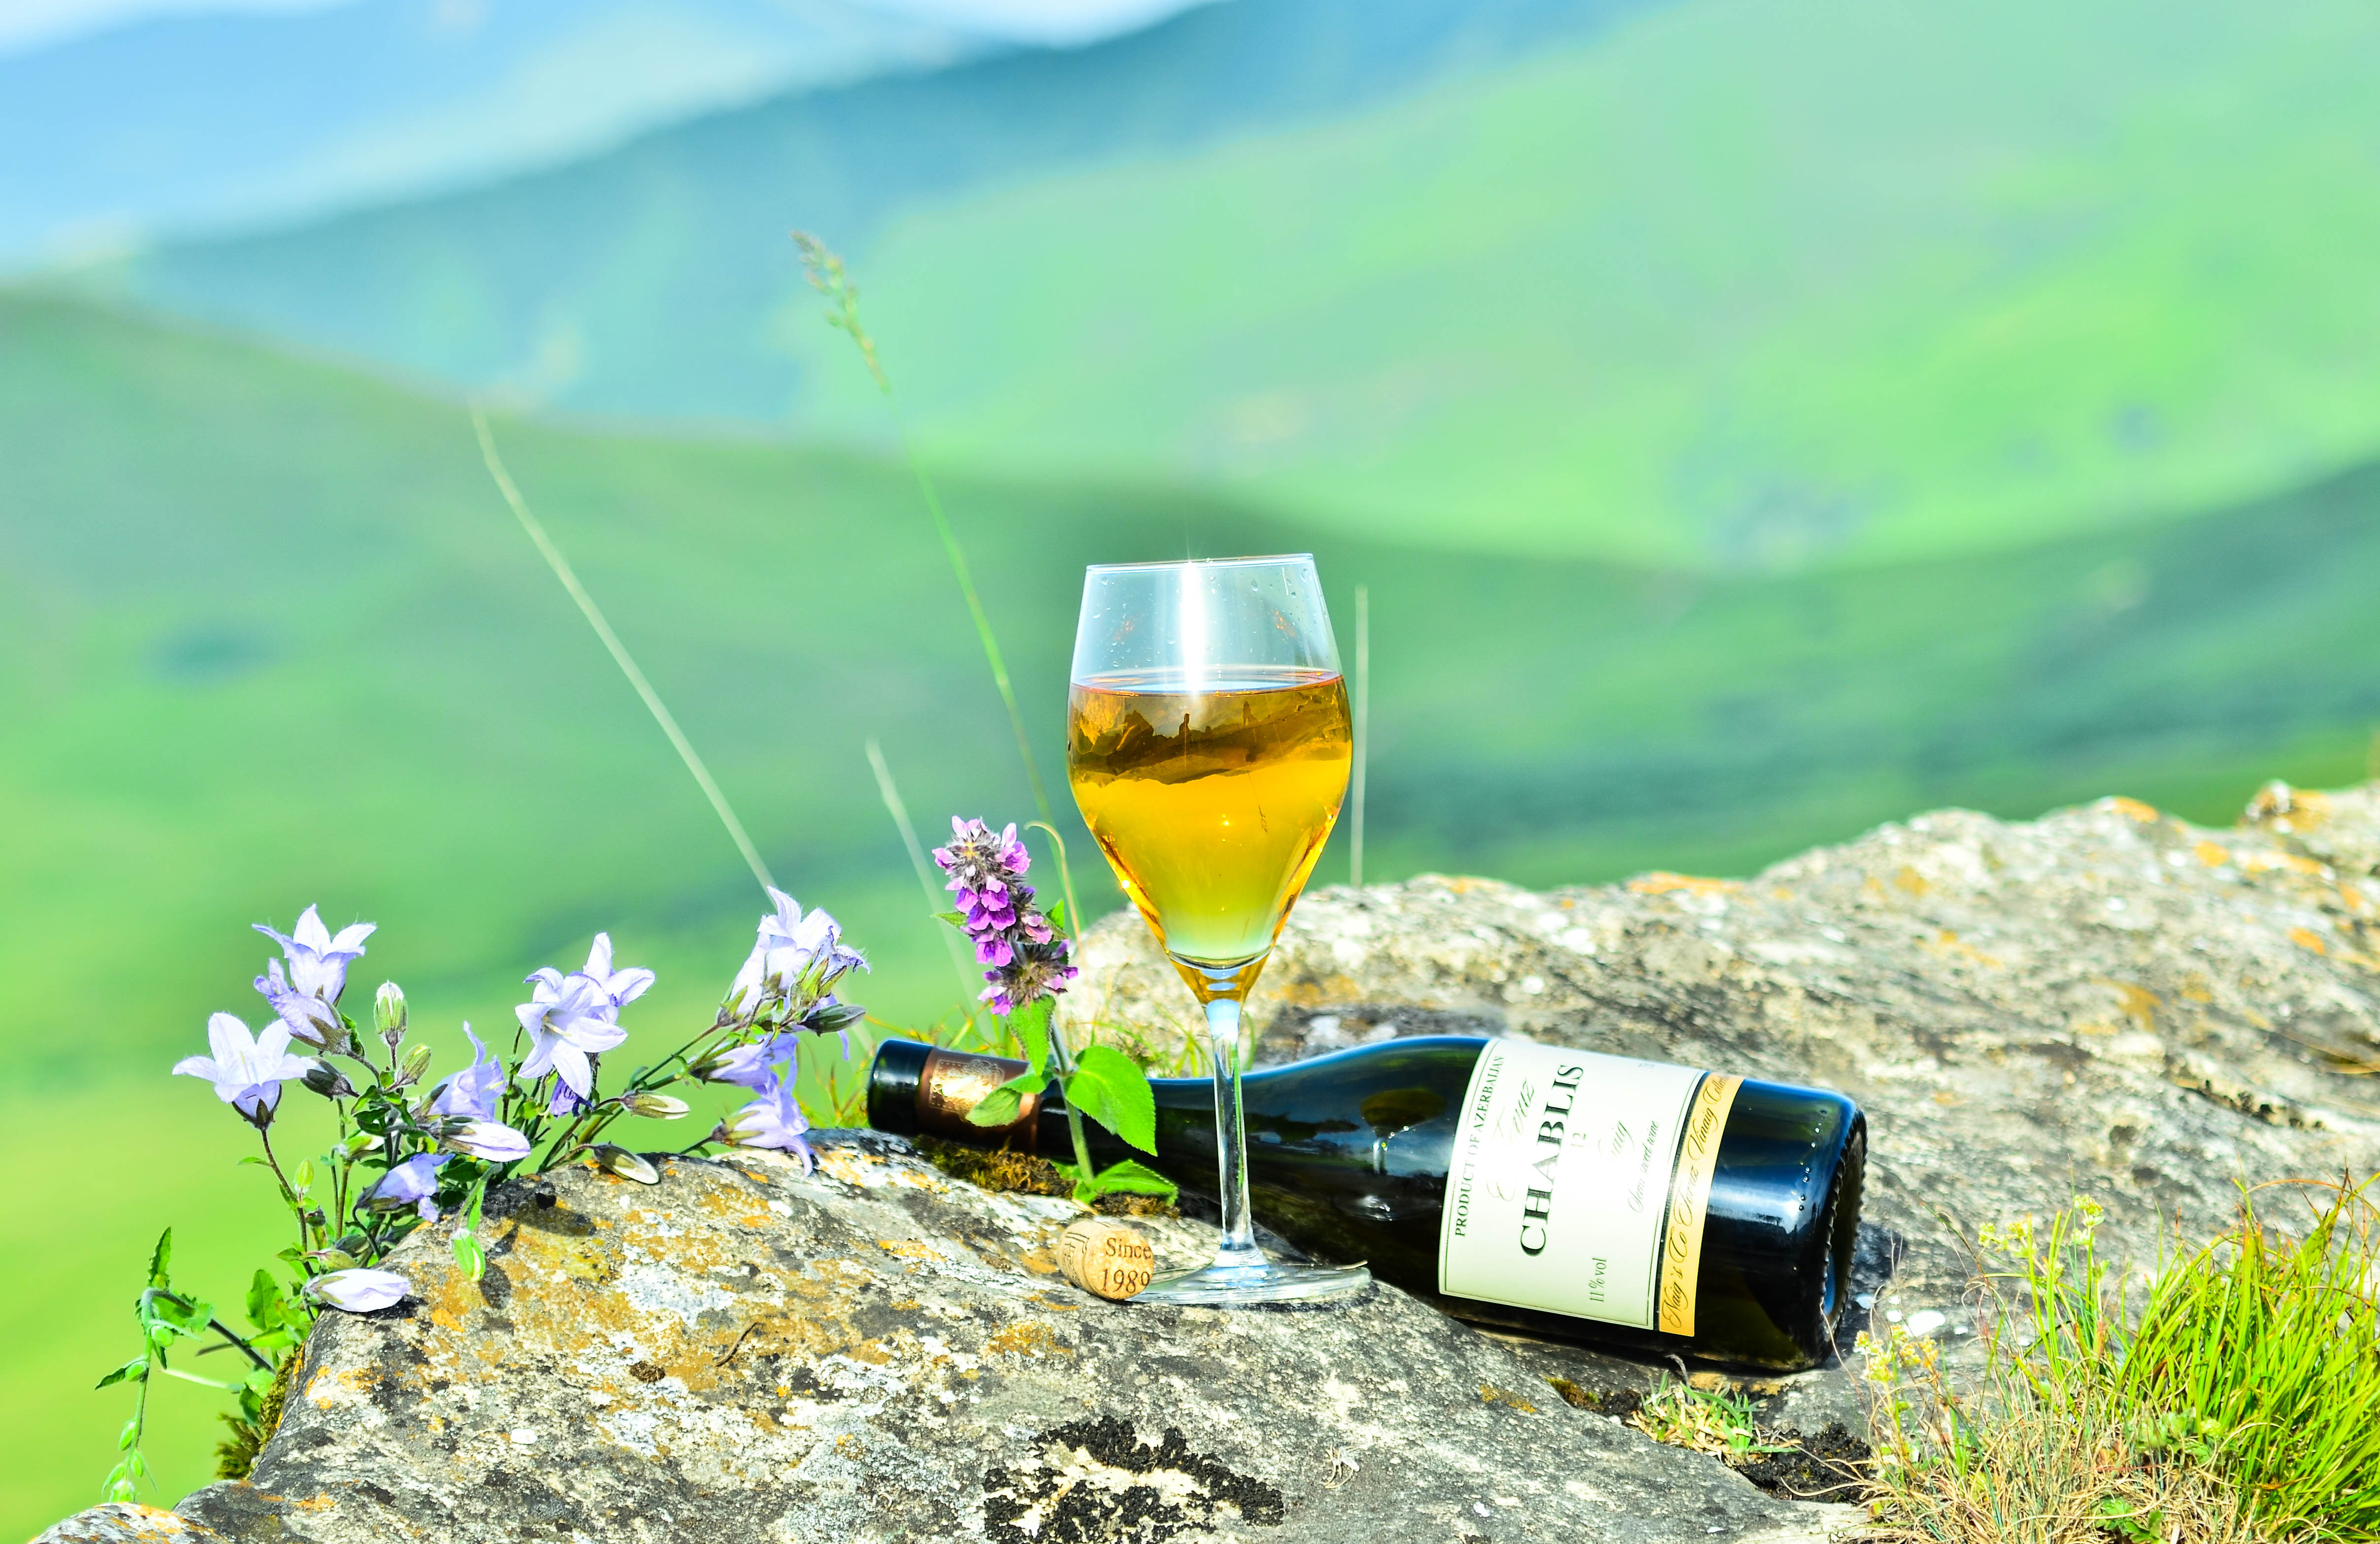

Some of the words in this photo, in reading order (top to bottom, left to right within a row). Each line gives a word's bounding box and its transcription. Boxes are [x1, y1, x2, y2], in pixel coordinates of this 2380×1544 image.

[1473, 1056, 1504, 1133] AZERBAIJAN
[1467, 1133, 1480, 1156] OF
[1647, 1119, 1660, 1146] wine
[1687, 1107, 1719, 1161] Vinaig
[1520, 1064, 1584, 1257] CHABLIS
[1455, 1160, 1475, 1238] PRODUCT
[1105, 1237, 1152, 1260] Since
[1592, 1257, 1607, 1276] vol
